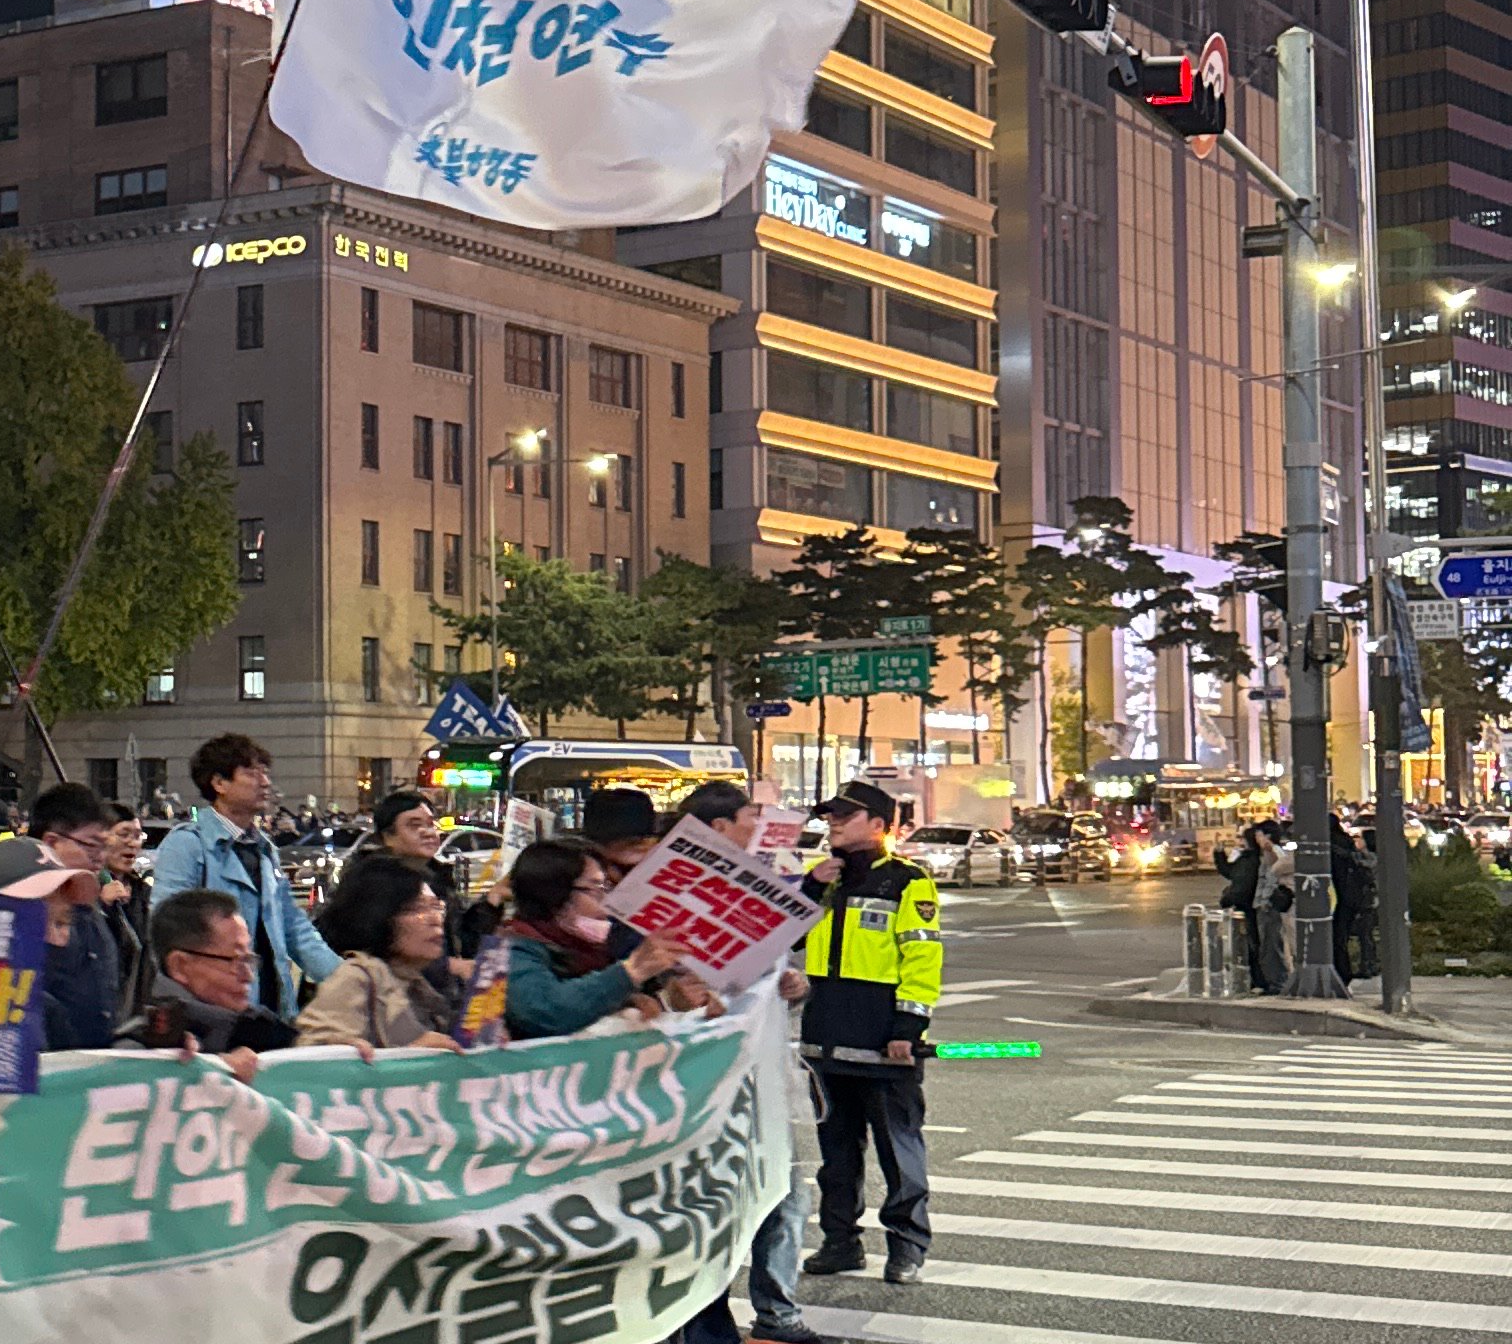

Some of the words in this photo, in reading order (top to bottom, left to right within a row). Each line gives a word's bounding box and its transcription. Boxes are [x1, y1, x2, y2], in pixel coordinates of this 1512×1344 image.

[765, 180, 840, 238] HeyDay
[225, 235, 307, 265] KEPCO
[334, 234, 409, 272] 한국전력
[647, 857, 788, 943] 윤석열
